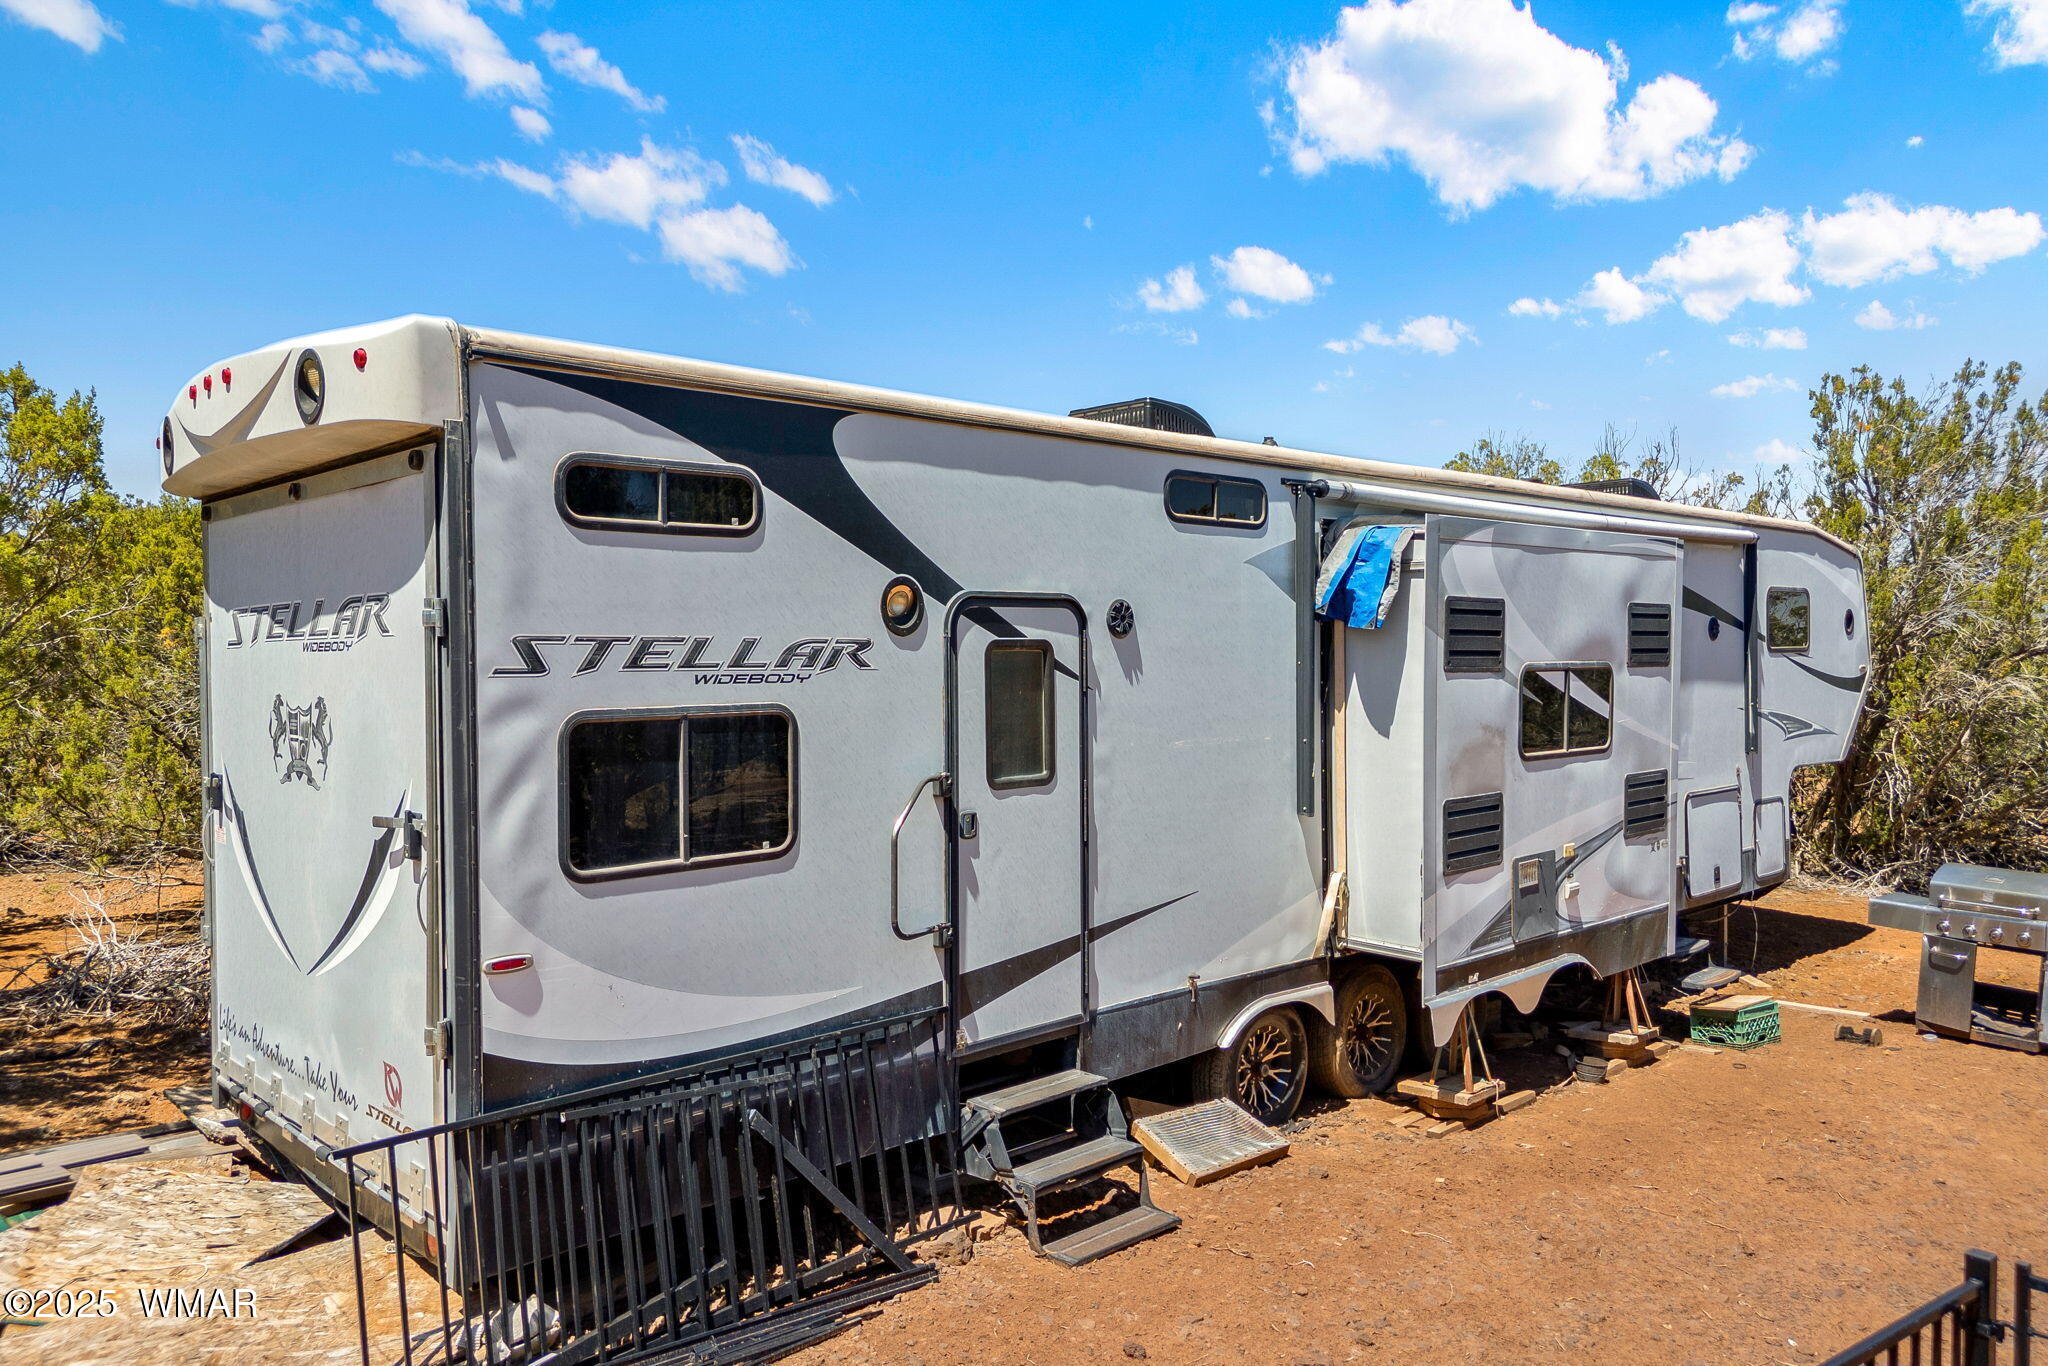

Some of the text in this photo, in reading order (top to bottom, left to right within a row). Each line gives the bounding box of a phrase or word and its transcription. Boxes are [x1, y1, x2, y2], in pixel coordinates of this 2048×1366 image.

[227, 593, 396, 649] STELLAR
[303, 641, 353, 652] WIDEBODY
[489, 635, 877, 678] STELLAR
[694, 673, 812, 685] WIDEBODY
[219, 1003, 237, 1041] Life's
[239, 1025, 251, 1042] an
[304, 1056, 328, 1093] Take
[329, 1070, 359, 1111] Your
